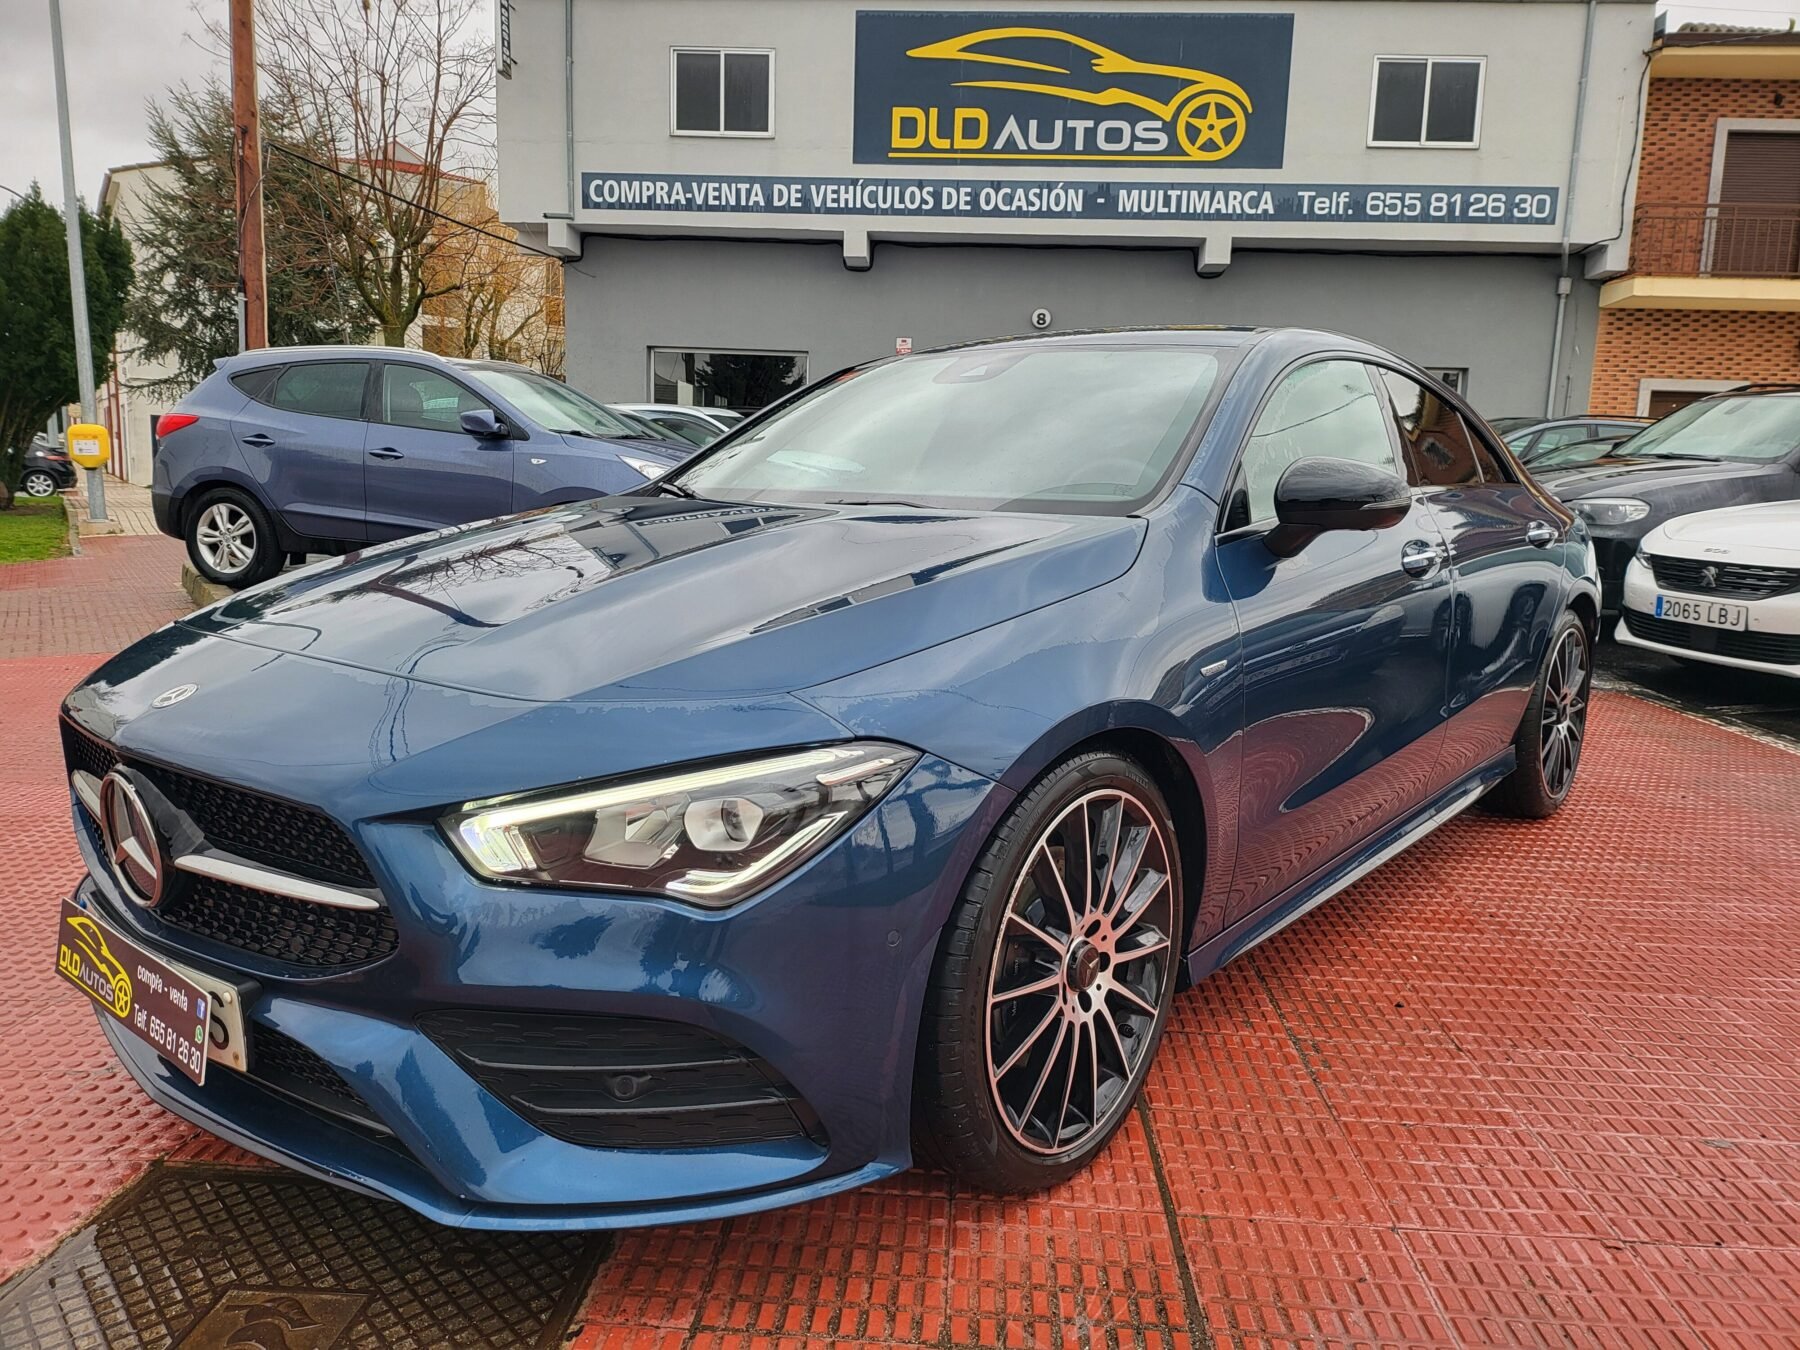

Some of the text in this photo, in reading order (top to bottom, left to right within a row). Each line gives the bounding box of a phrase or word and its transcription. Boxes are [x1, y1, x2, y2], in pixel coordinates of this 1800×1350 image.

[891, 106, 1169, 152] DLD AUTOS
[588, 179, 766, 207] COMPRA-VENTA
[772, 184, 802, 207] DE
[810, 179, 934, 211] VEHÍCULOS
[941, 187, 972, 211] DE
[979, 182, 1084, 212] OCASIÓN
[1117, 189, 1276, 215] MULTIMARCA
[1297, 191, 1354, 216] Telf.
[1365, 191, 1422, 217] 655
[1512, 194, 1552, 219] 30
[1036, 312, 1047, 326] 8
[1663, 600, 1741, 626] 2065 LBJ
[60, 944, 114, 1003] DLD AUTOS
[137, 964, 163, 994] compra
[169, 986, 188, 1012] venta
[133, 1003, 201, 1074] Telf. 655 81 26 30
